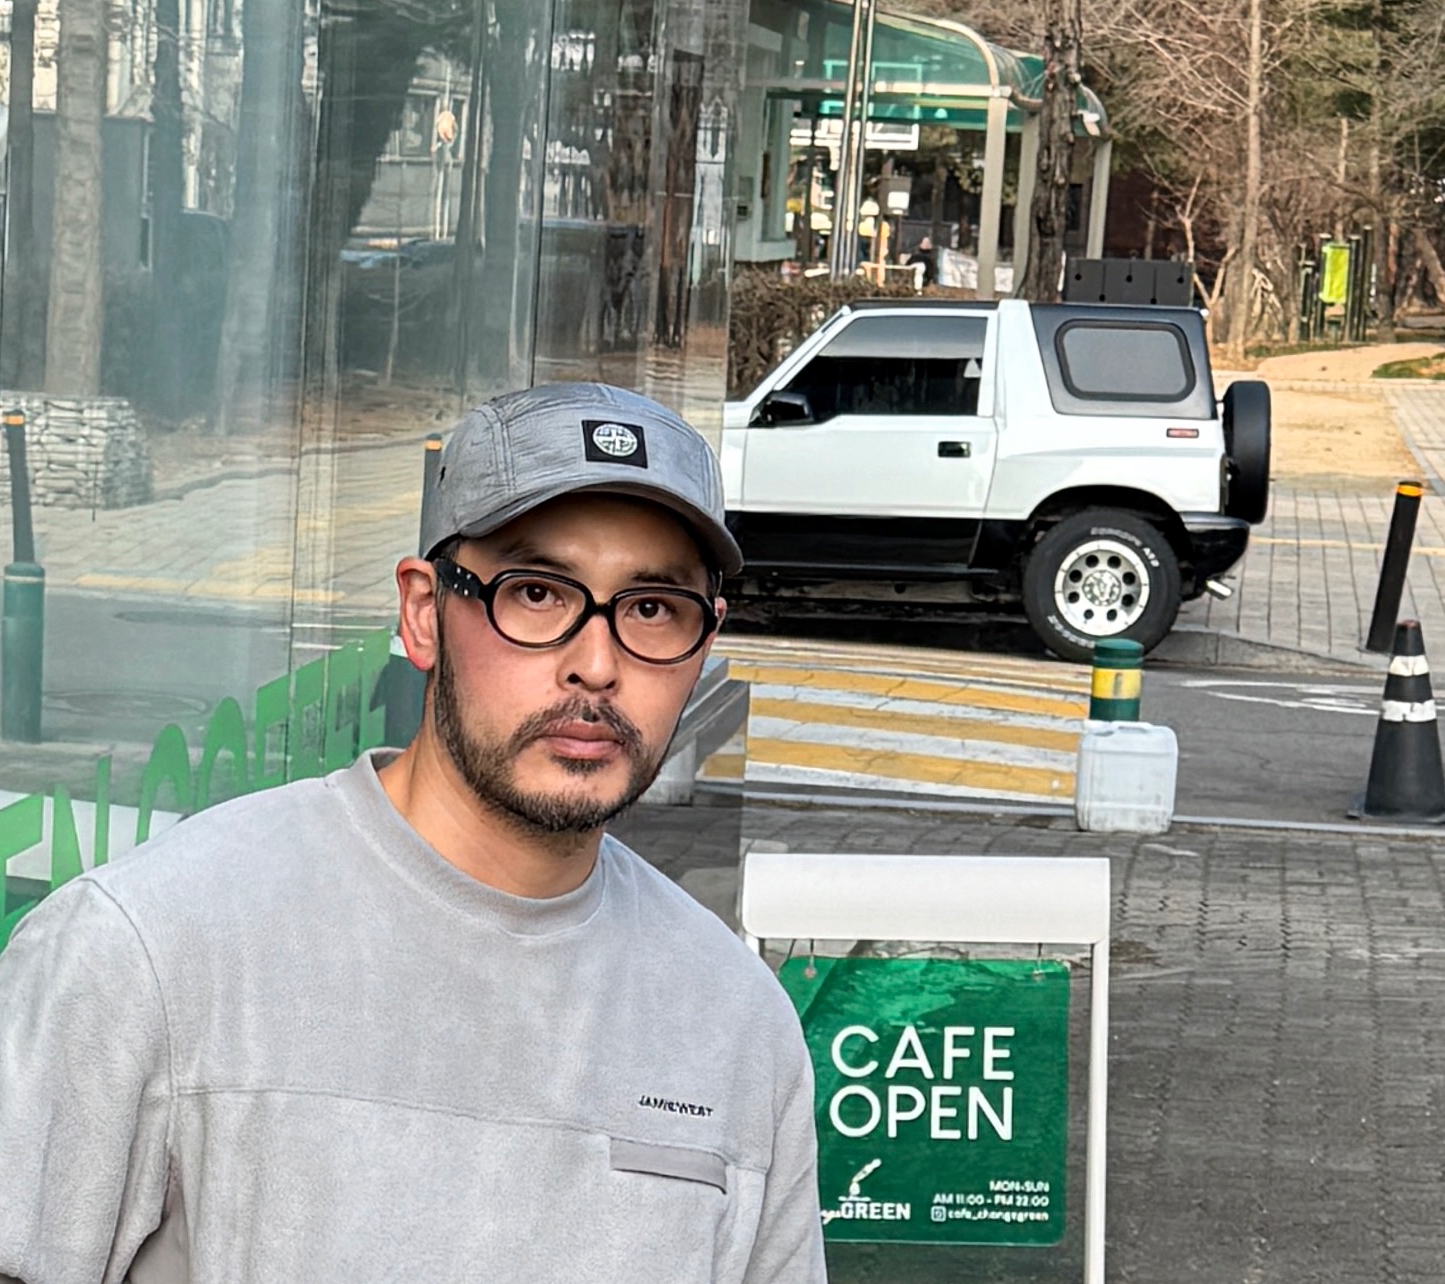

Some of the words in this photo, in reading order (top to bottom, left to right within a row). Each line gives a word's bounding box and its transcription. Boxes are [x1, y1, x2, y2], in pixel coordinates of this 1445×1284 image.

[831, 1024, 1015, 1080] CAFE
[829, 1084, 1013, 1140] OPEN
[933, 1193, 953, 1204] AM
[994, 1194, 1013, 1205] PM
